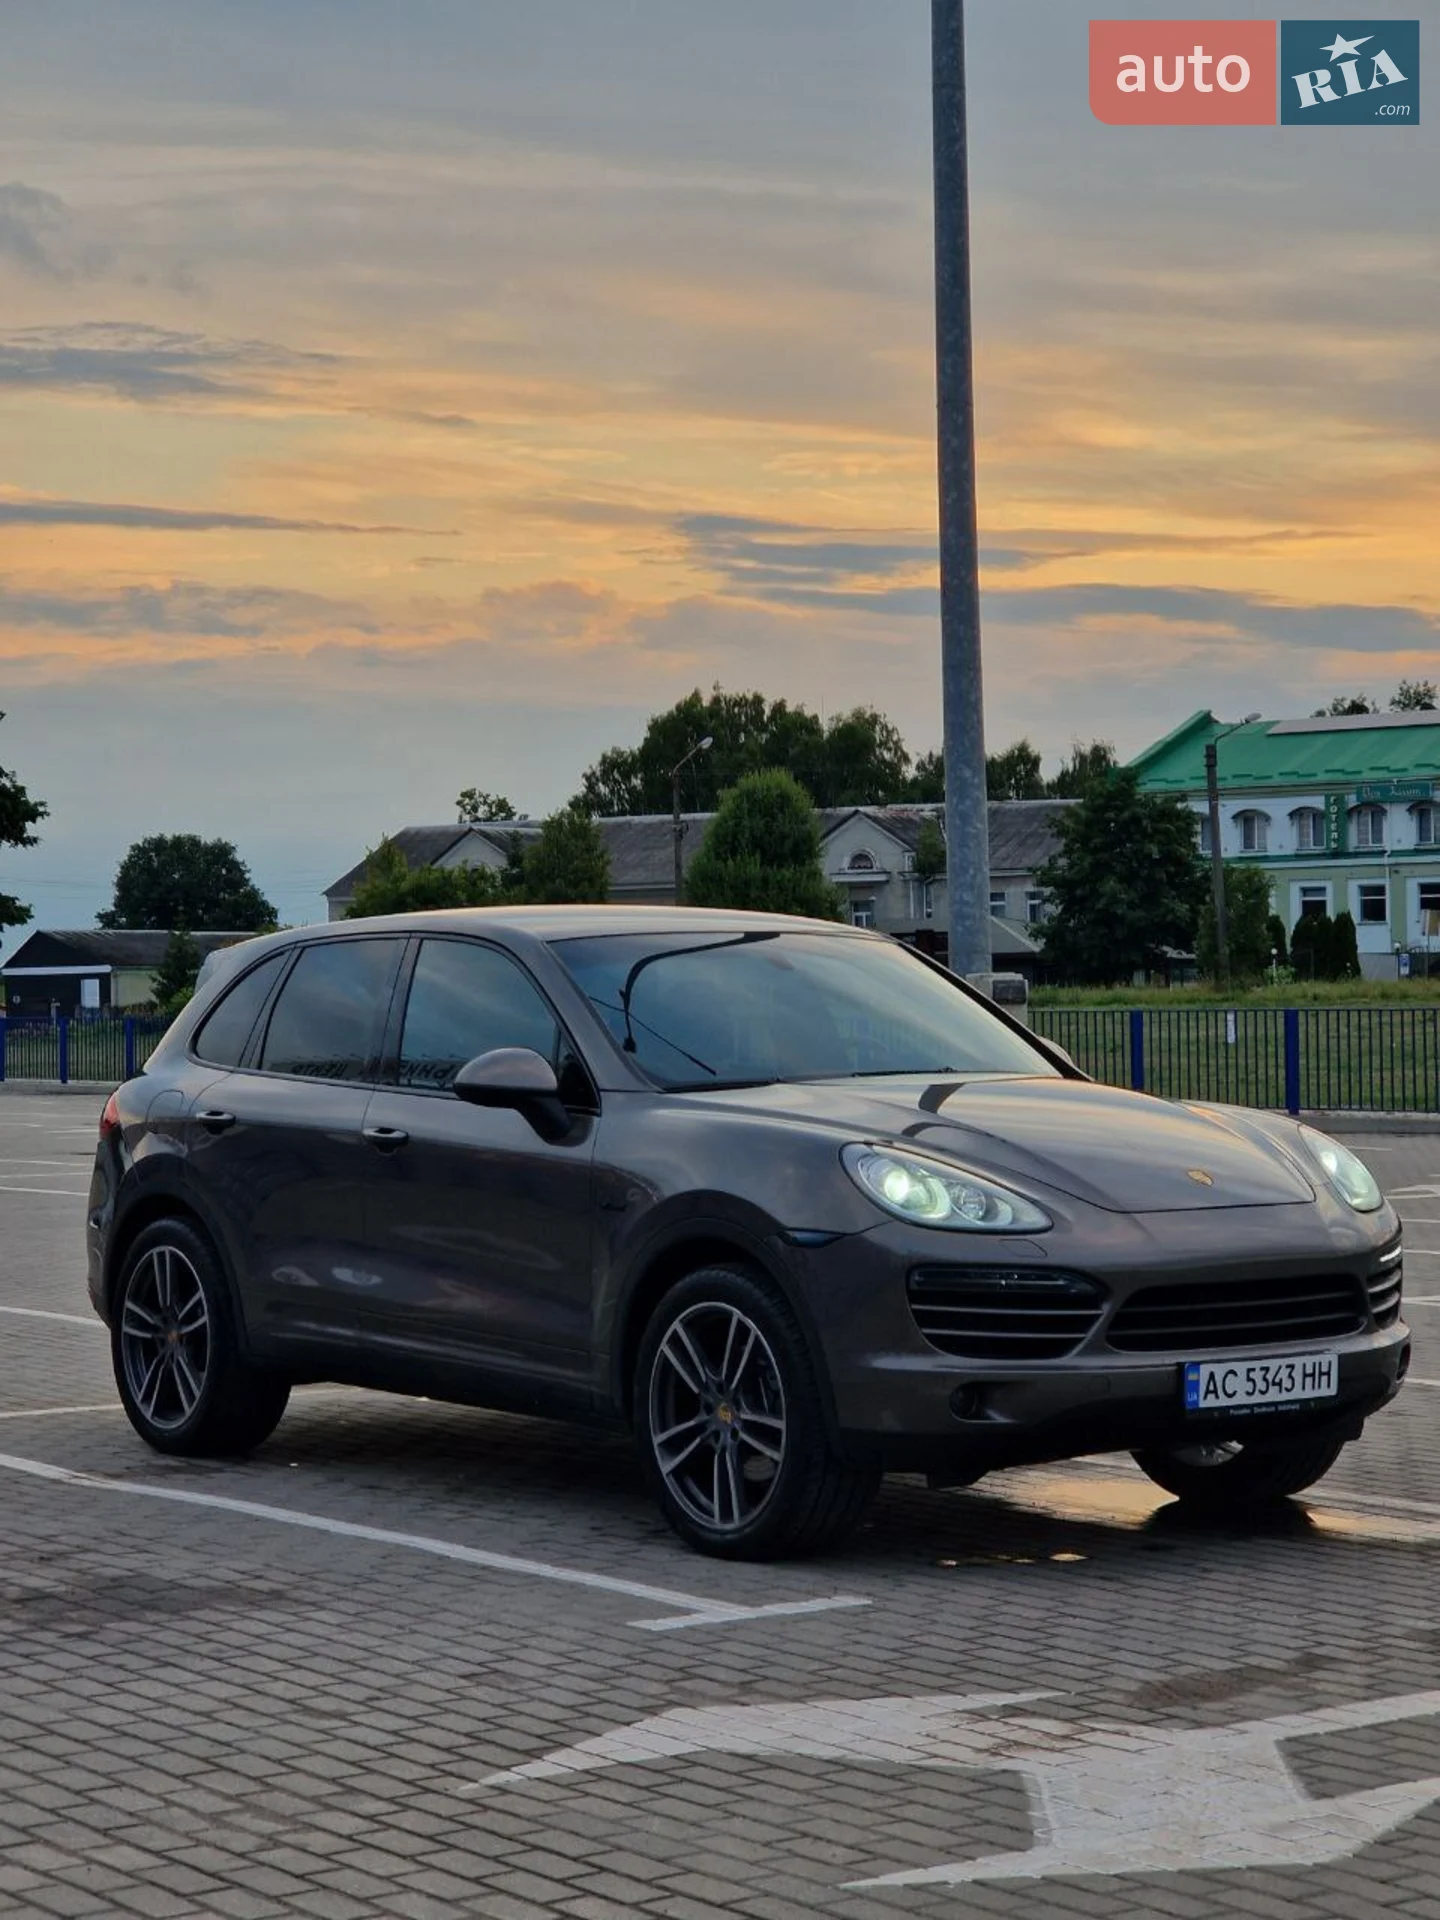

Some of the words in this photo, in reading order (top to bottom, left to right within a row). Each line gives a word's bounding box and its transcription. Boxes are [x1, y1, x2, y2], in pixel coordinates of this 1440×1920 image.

[1329, 796, 1339, 849] ГОТЕЛЬ
[1187, 1391, 1198, 1402] UA
[1203, 1369, 1239, 1401] AC
[1245, 1363, 1296, 1396] 5343
[1301, 1360, 1332, 1391] HH
